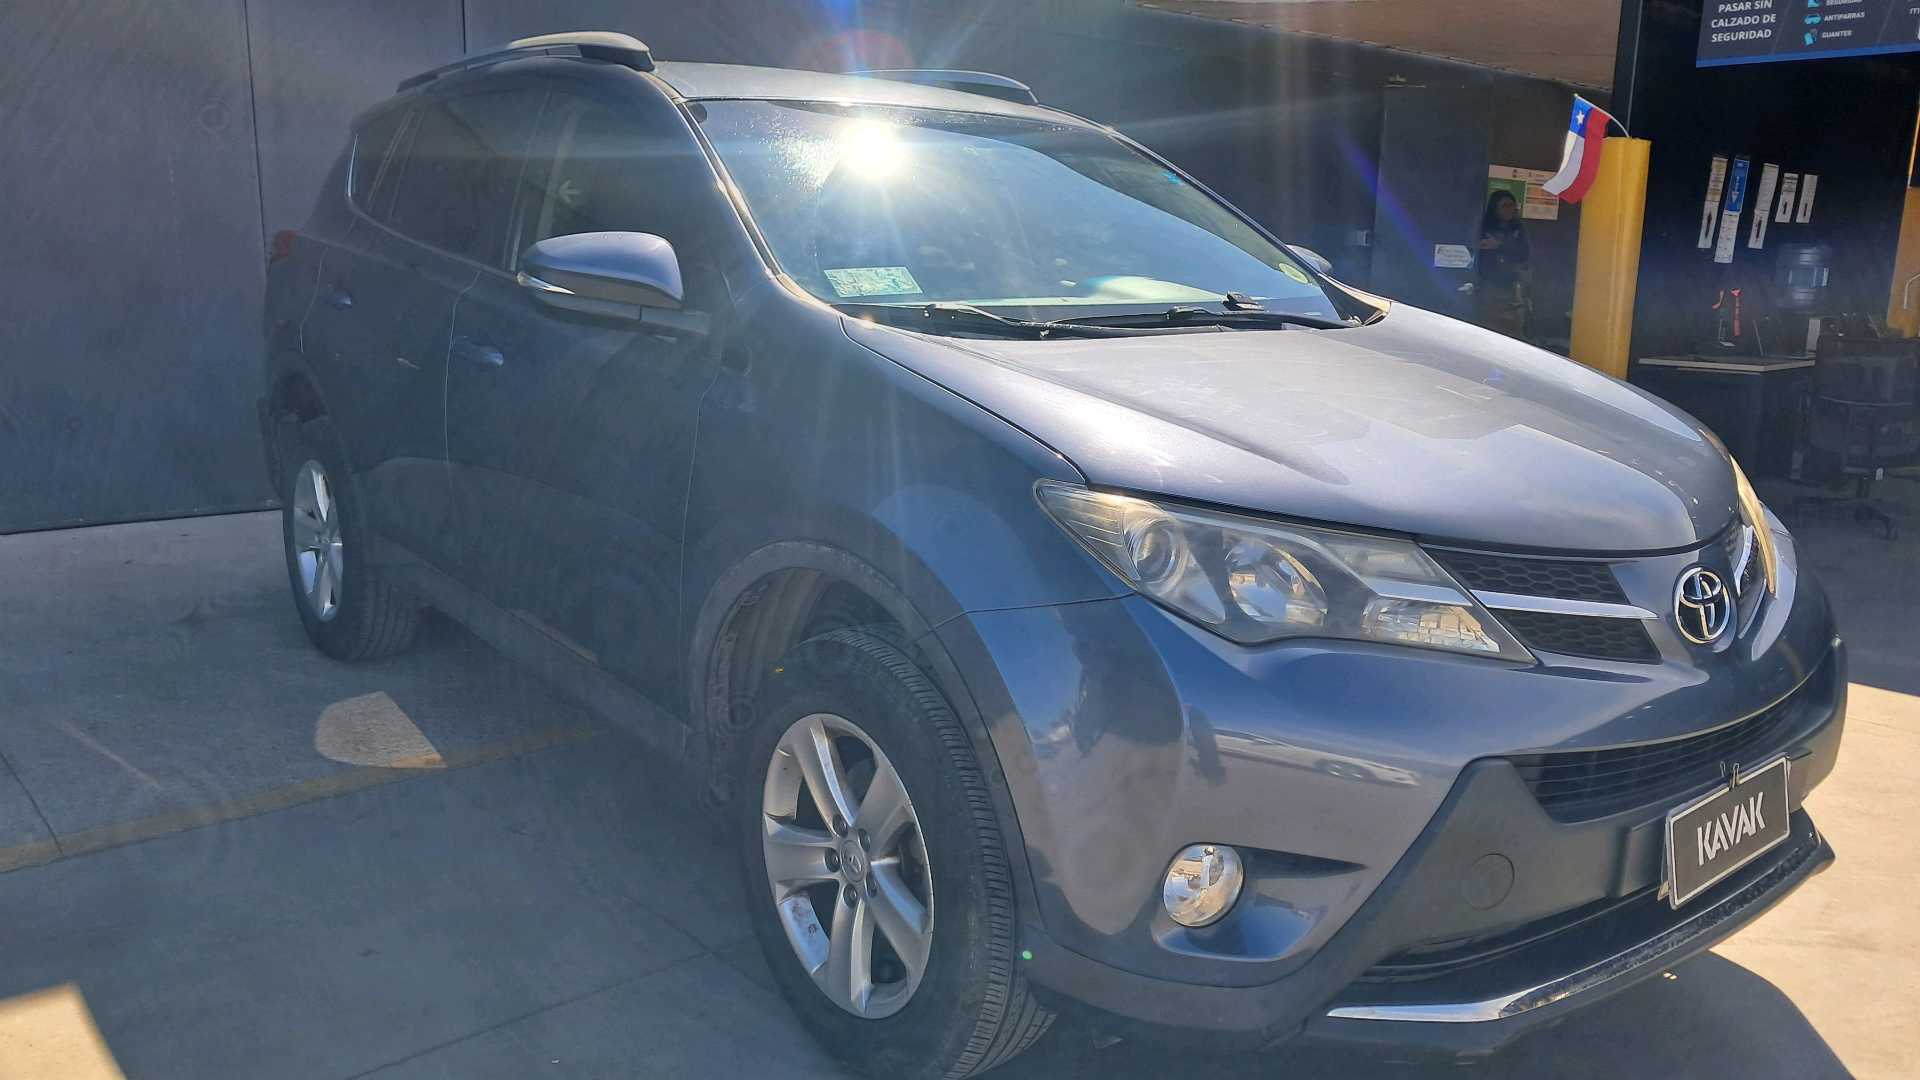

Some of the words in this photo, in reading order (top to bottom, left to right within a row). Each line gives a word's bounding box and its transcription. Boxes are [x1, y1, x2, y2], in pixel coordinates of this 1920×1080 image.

[1719, 1, 1752, 13] PASAR
[1754, 0, 1773, 10] SIN
[1711, 15, 1760, 28] CALZADO
[1762, 14, 1777, 24] DE
[1711, 29, 1772, 43] SEGURIDAD
[1697, 791, 1766, 866] KAVAK
